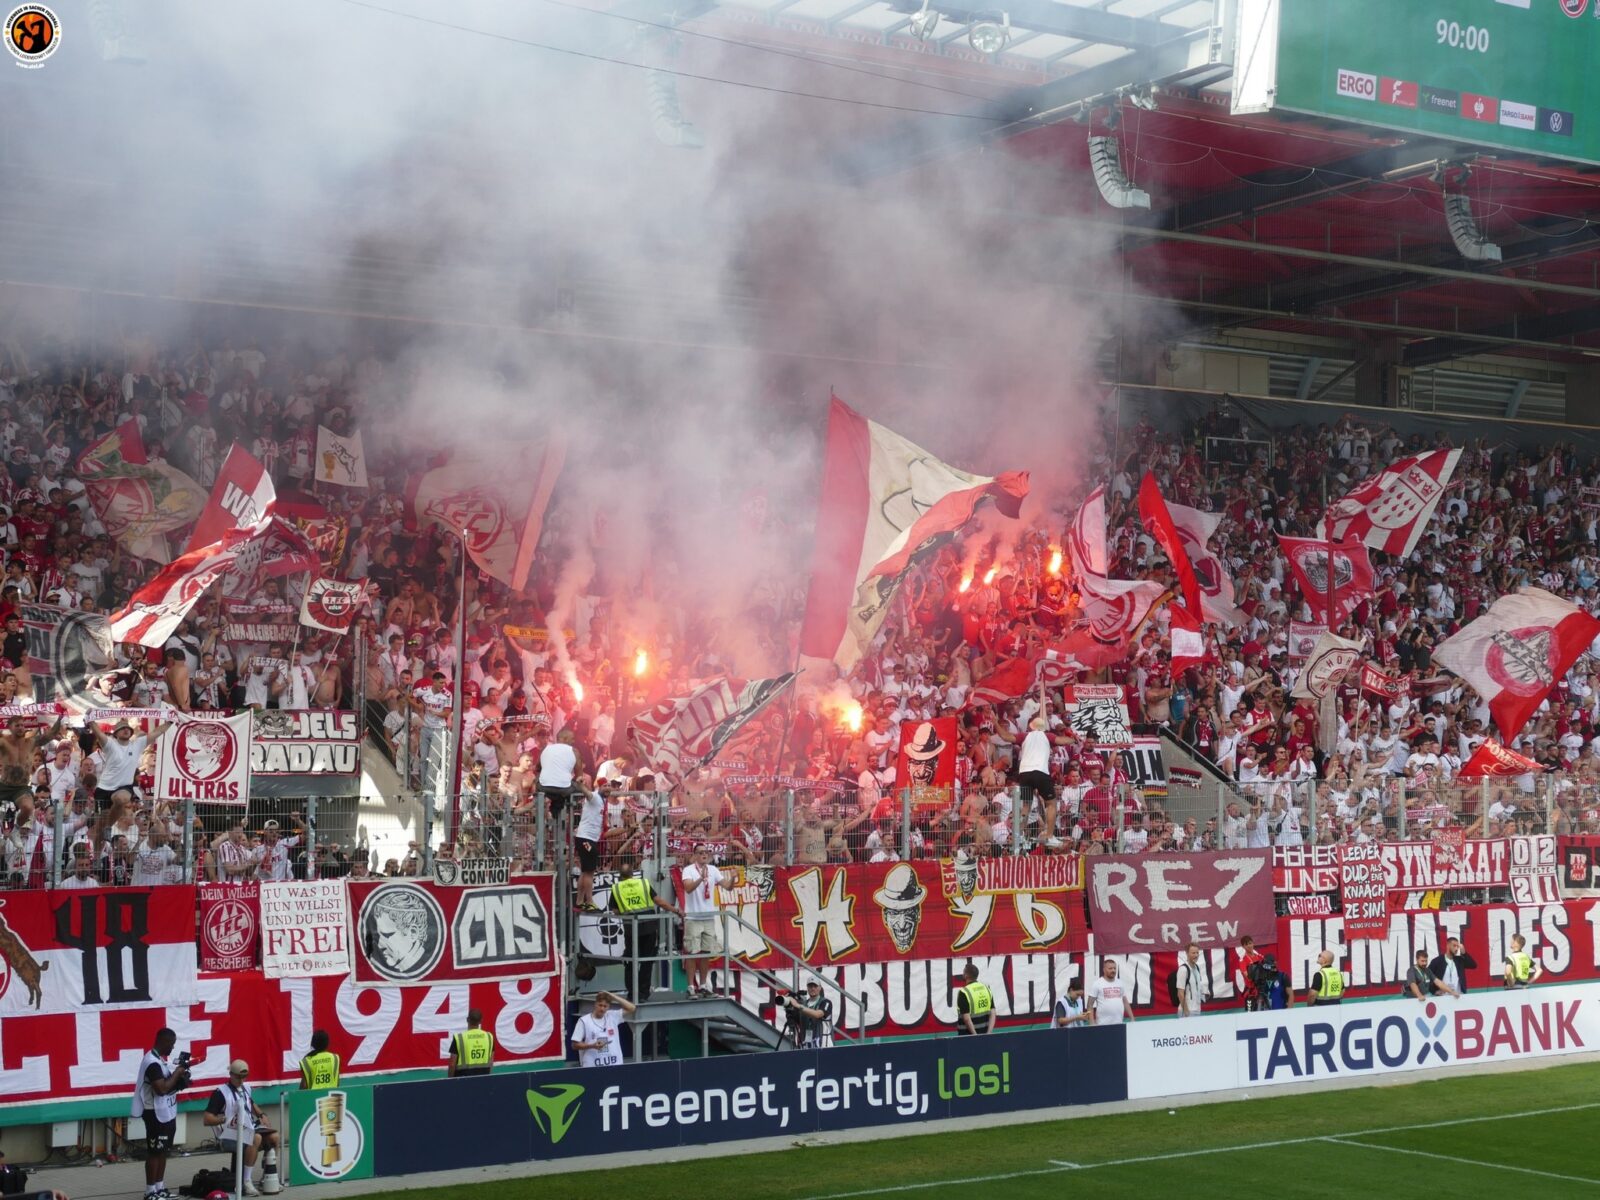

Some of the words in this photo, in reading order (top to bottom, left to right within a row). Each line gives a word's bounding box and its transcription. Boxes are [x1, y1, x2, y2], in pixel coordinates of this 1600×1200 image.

[1436, 19, 1489, 53] 90:00
[1339, 74, 1375, 96] ERGO
[1431, 94, 1457, 109] freenet
[168, 777, 239, 800] ULTRAS
[1341, 846, 1380, 862] LEEVER
[977, 853, 1080, 891] STADIONVERBOT
[1273, 867, 1339, 892] JUNGS
[201, 887, 224, 901] DEIN
[264, 888, 281, 899] TU
[287, 886, 317, 898] WAS
[322, 885, 341, 896] DU
[627, 895, 642, 906] 762
[264, 901, 292, 913] TUN
[295, 898, 342, 911] WILLST
[1345, 903, 1361, 919] ZE
[1362, 900, 1386, 918] SIN!
[266, 915, 292, 926] UND
[295, 914, 313, 925] DU
[317, 912, 343, 923] BIST
[459, 893, 543, 961] CNS
[266, 925, 345, 956] FREI
[1128, 920, 1239, 945] CREW
[1487, 903, 1570, 976] DES
[279, 972, 554, 1074] 1948
[471, 1048, 486, 1059] 657
[315, 1074, 331, 1085] 638
[601, 1076, 790, 1133] freenet,
[797, 1061, 929, 1116] fertig,
[937, 1051, 1010, 1100] los!
